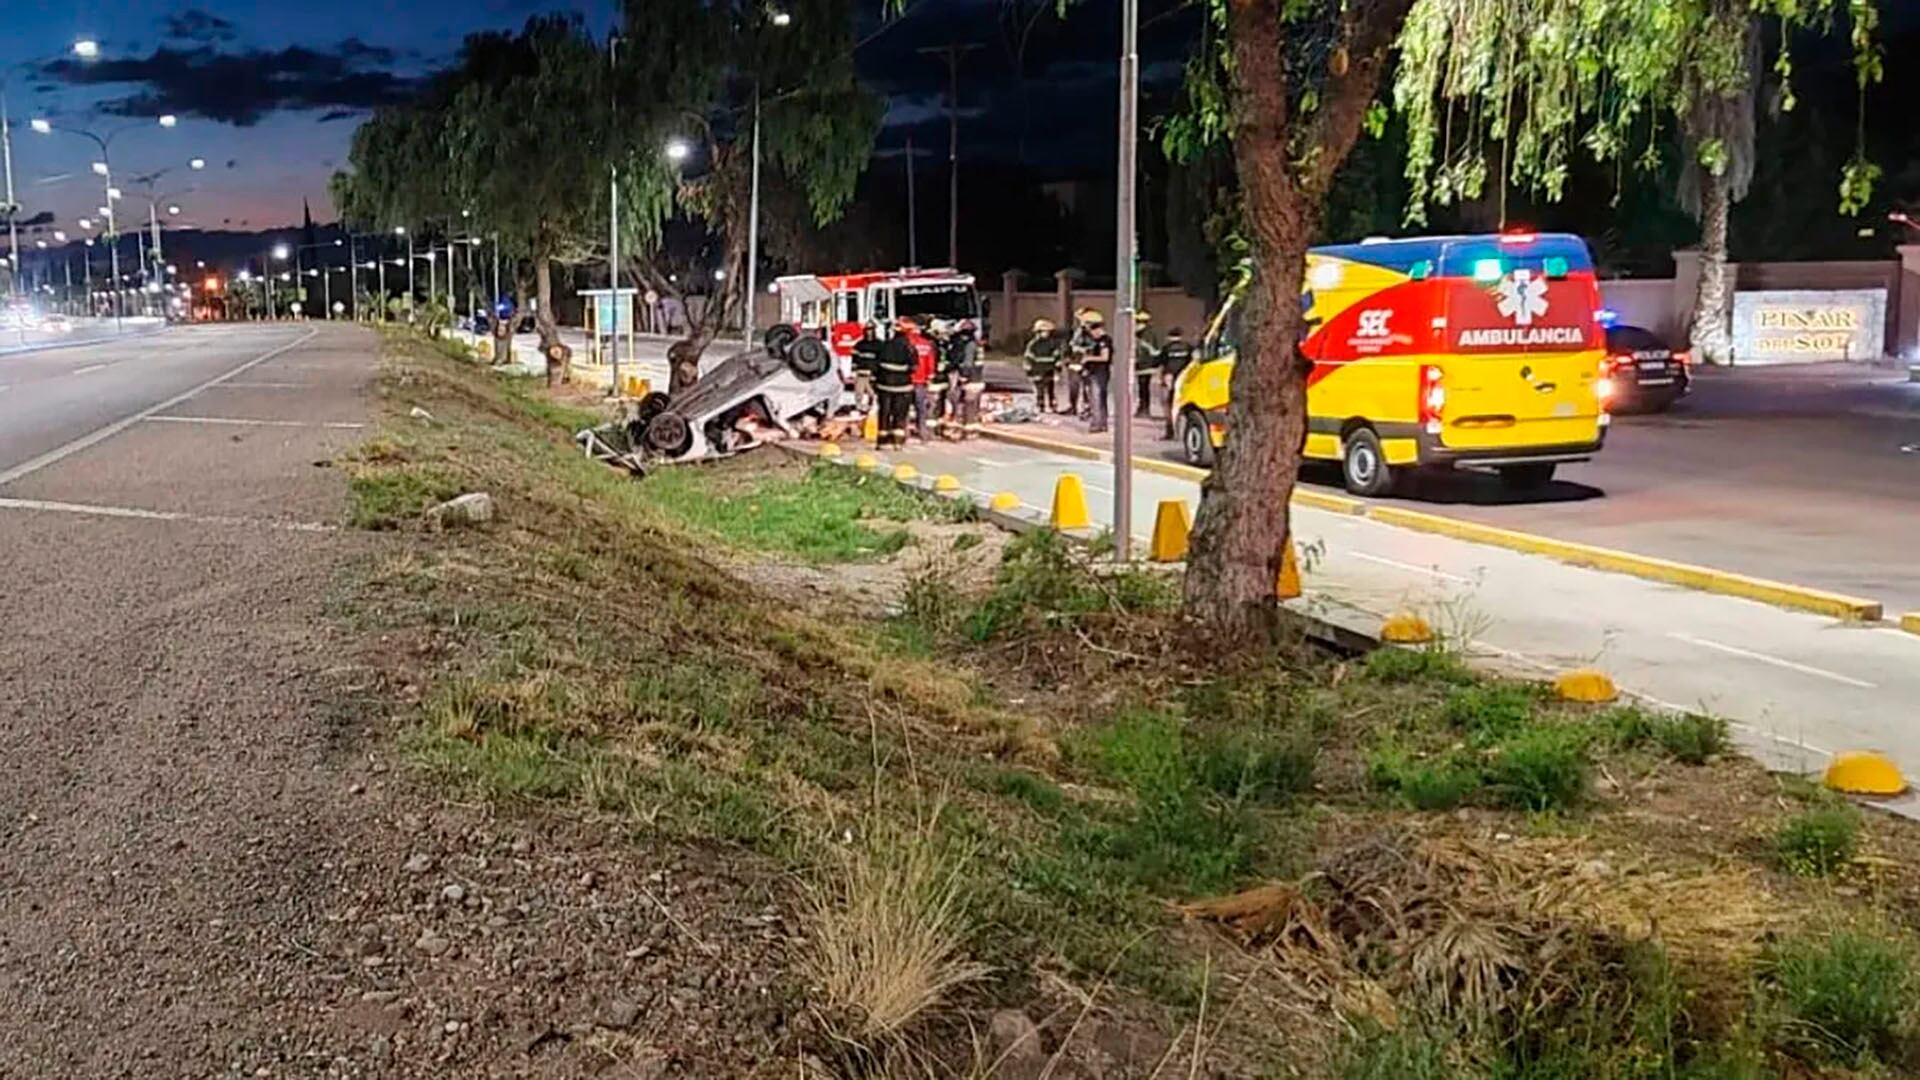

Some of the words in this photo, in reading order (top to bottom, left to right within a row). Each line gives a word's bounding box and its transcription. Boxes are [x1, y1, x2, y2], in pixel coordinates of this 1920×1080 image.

[1356, 309, 1394, 336] SEC
[1759, 311, 1853, 328] PINAR
[1459, 328, 1583, 346] AMBULANCIA
